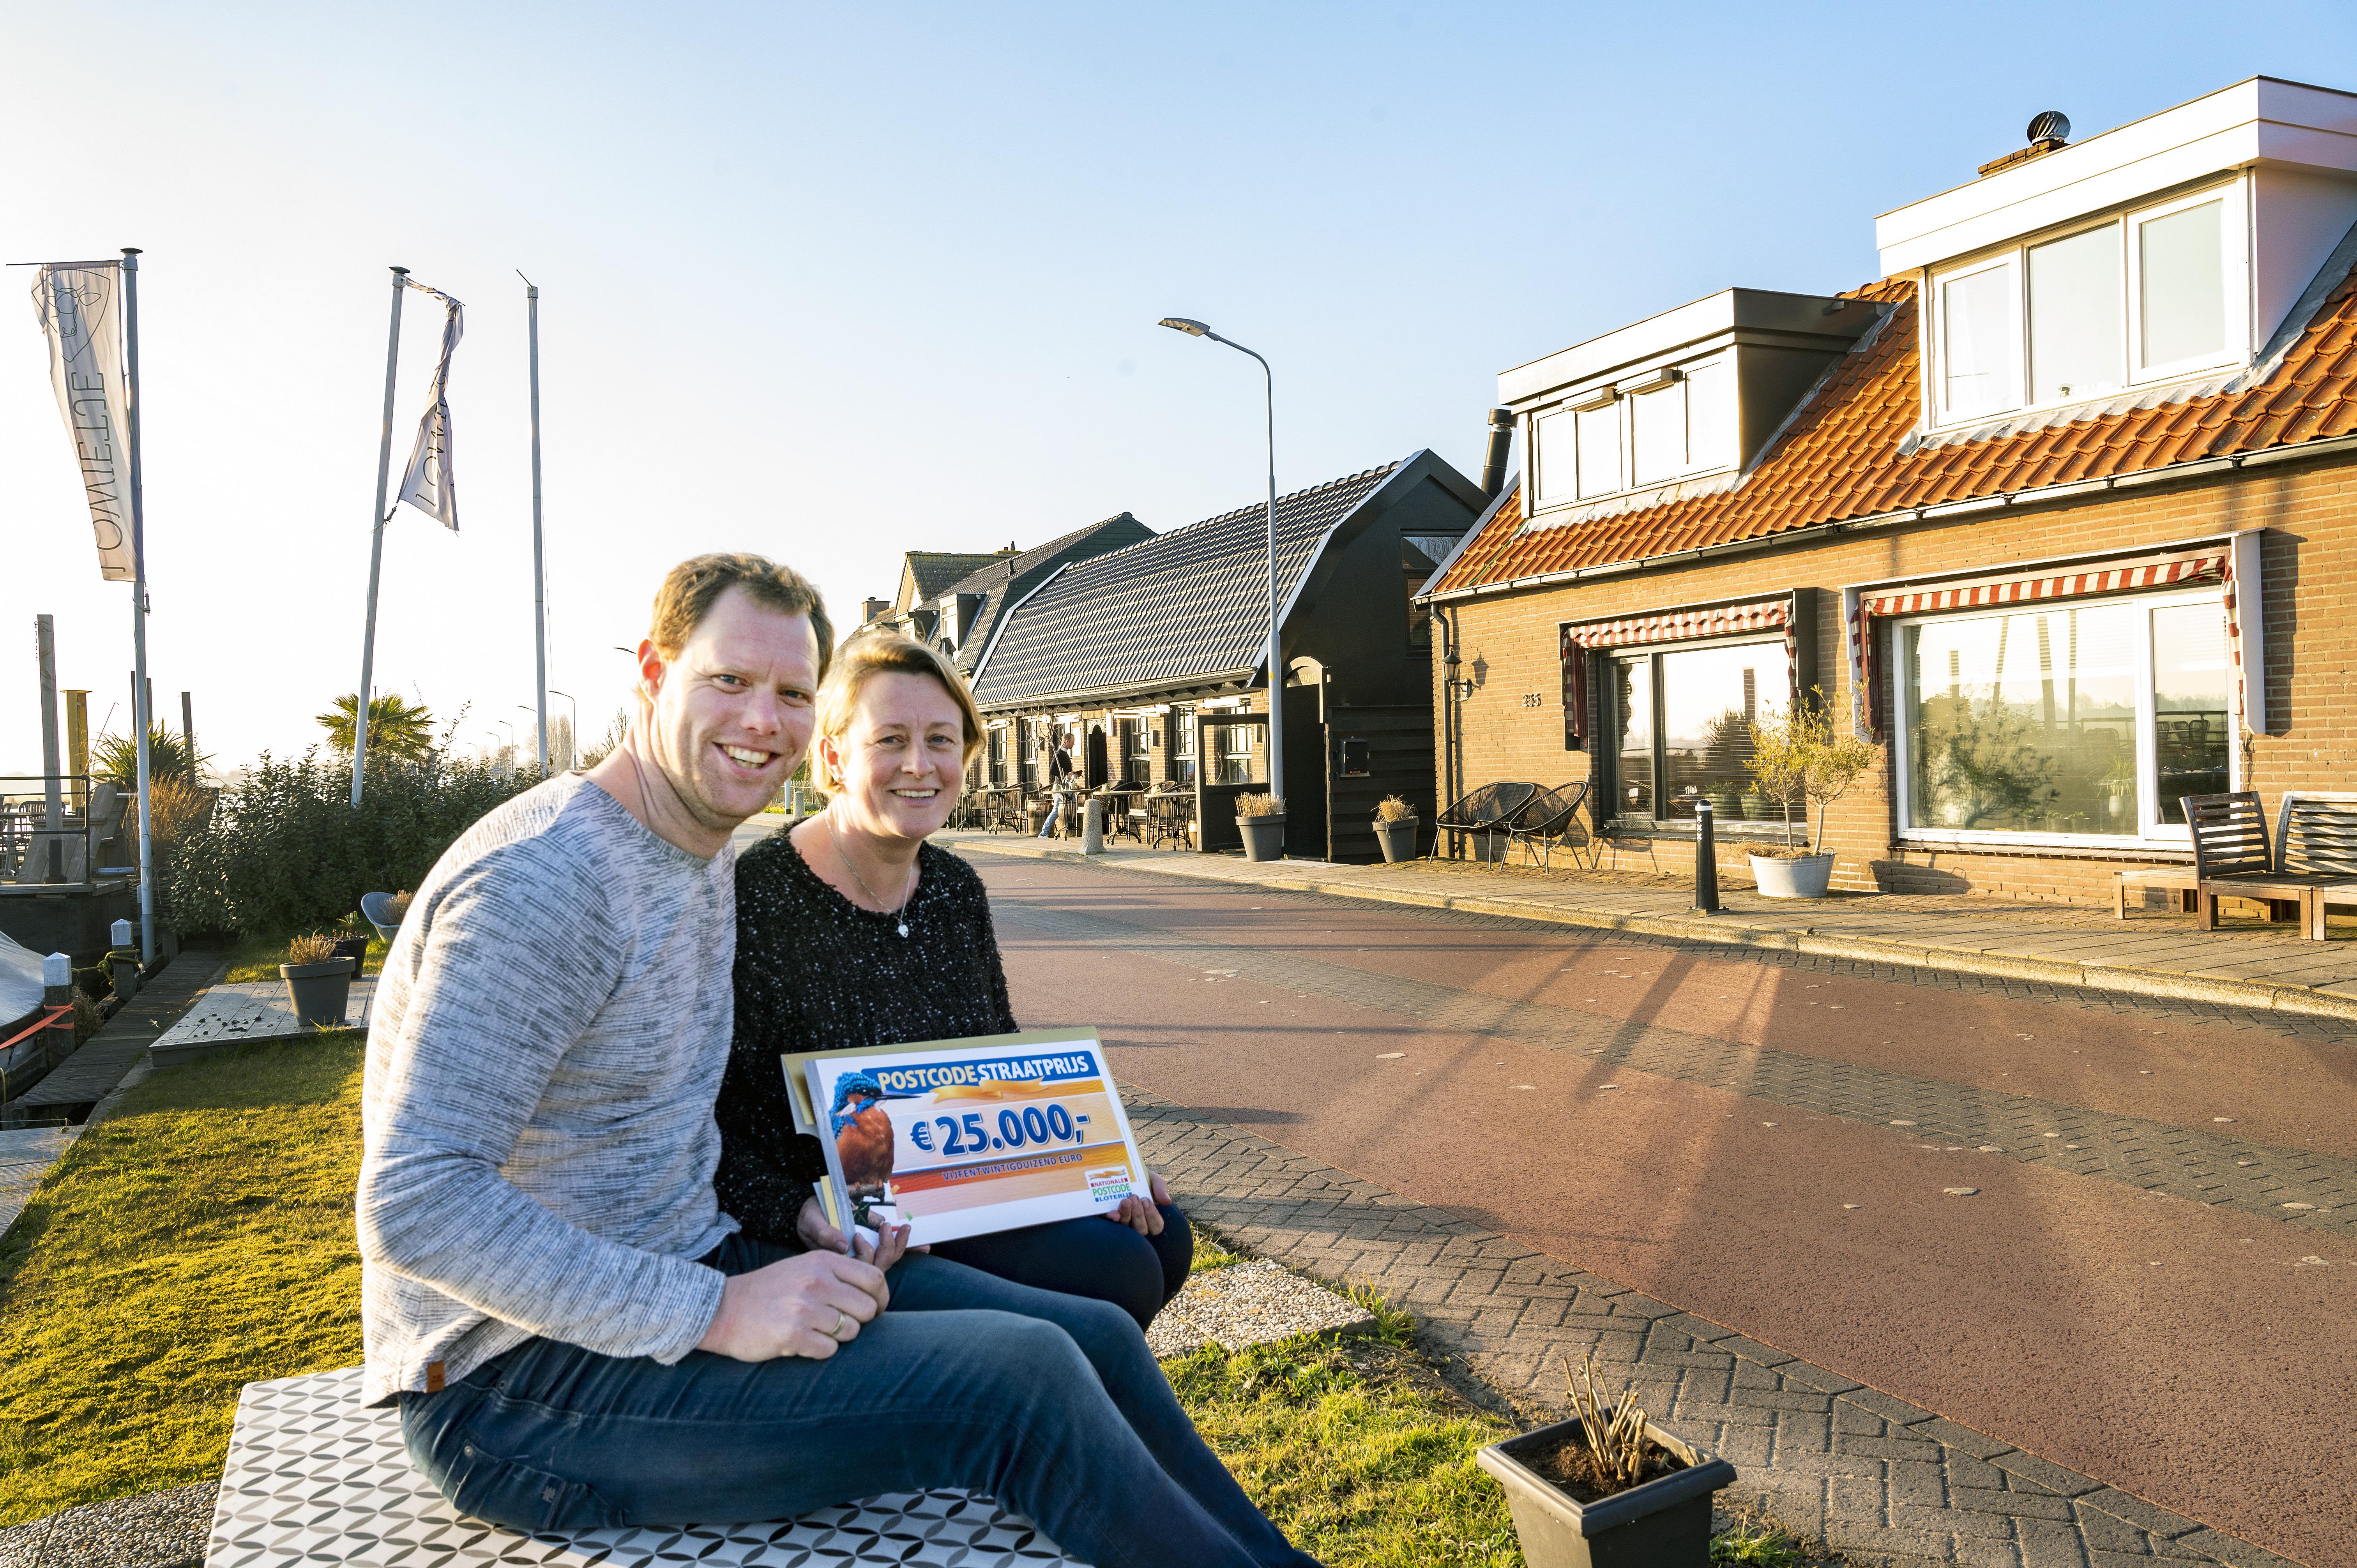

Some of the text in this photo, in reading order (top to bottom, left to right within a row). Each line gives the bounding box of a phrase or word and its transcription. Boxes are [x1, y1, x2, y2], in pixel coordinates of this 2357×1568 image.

[1295, 673, 1316, 683] INGANG
[1521, 693, 1539, 707] 255
[942, 1153, 1083, 1181] VIJFENTWINTIGDUIZEND EURO
[1092, 1183, 1131, 1197] POSTCODE
[1094, 1179, 1125, 1187] NATIONALE
